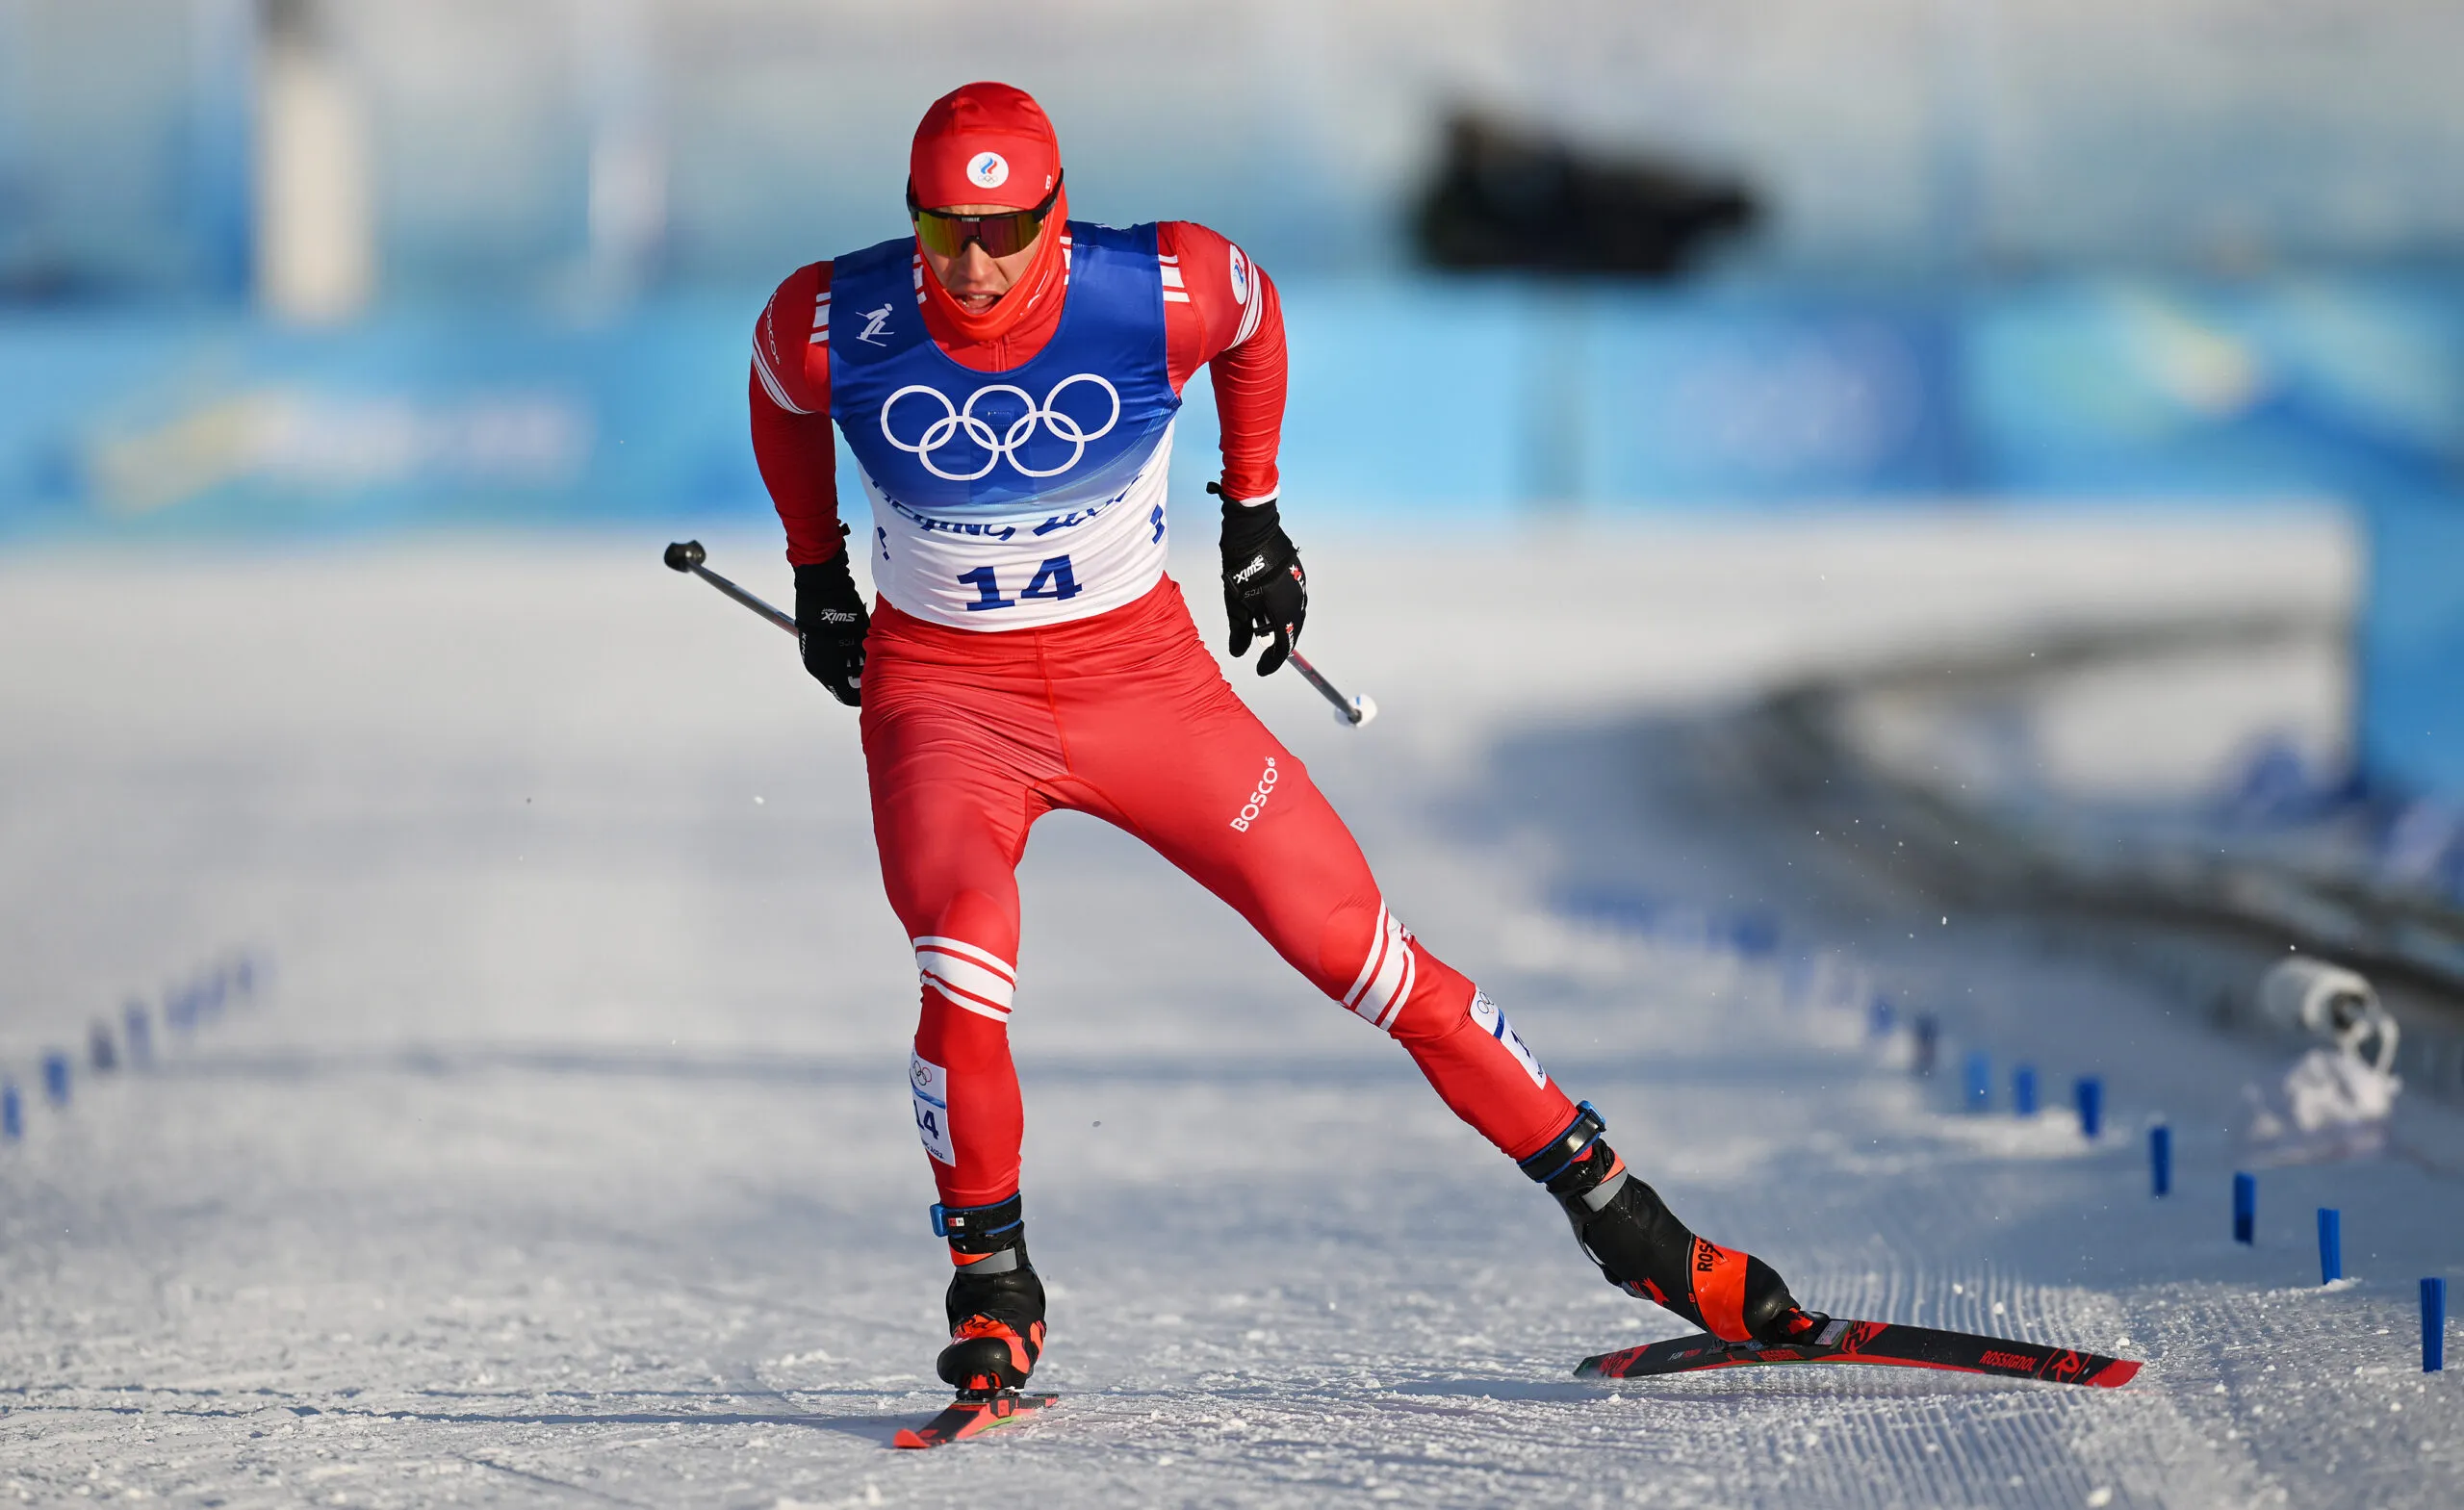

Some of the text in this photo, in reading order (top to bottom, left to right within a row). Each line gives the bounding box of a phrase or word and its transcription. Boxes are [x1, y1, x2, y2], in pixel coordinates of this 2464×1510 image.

[957, 554, 1083, 612] 14
[1229, 766, 1279, 833] BOSCO
[1979, 1349, 2038, 1372] ROSSIGNOL
